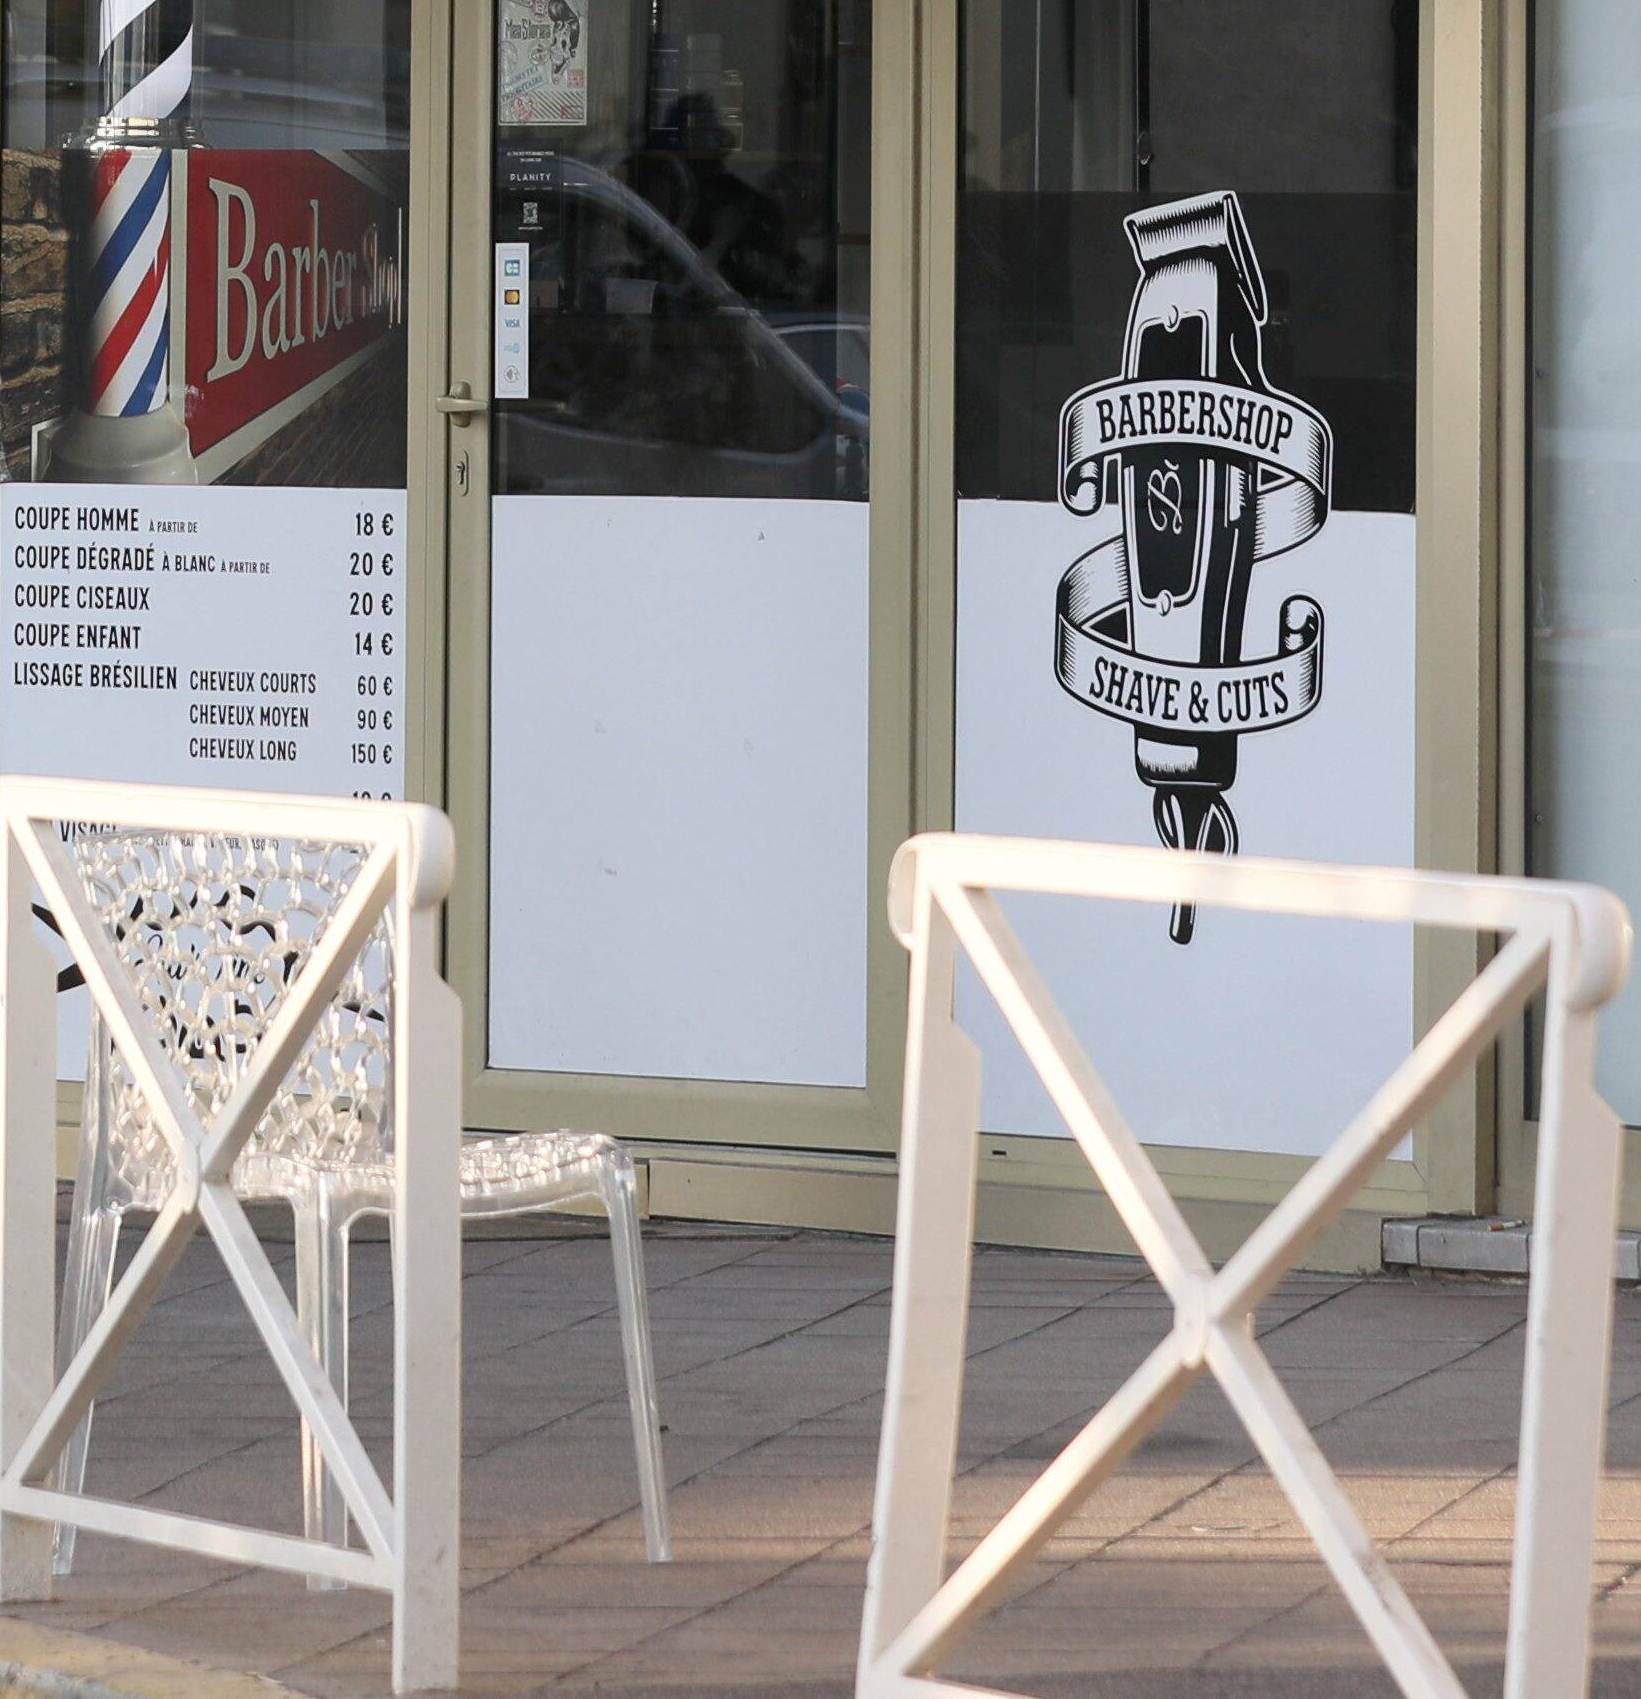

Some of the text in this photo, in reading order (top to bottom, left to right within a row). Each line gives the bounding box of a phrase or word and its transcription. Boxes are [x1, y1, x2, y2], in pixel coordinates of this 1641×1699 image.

[509, 173, 552, 182] PLANITY
[207, 176, 357, 384] Barber
[505, 319, 521, 329] VISA
[1096, 390, 1293, 455] BARBERSHOP
[15, 507, 70, 530] COUPE
[78, 508, 139, 531] HOMME
[157, 521, 185, 532] PARTIR
[188, 522, 197, 533] DE
[356, 513, 373, 536] 18
[382, 513, 393, 536] €
[15, 546, 69, 569] COUPE
[77, 542, 154, 571] DÉGRADÉ
[162, 553, 169, 571] À
[175, 555, 215, 572] BLANC
[229, 562, 257, 573] PARTIR
[260, 563, 270, 574] DE
[351, 553, 373, 575] 20
[382, 554, 393, 576] €
[15, 584, 392, 615] COUPE CISEAUX 20 €
[15, 623, 392, 655] COUPE ENFANT 14 €
[15, 661, 392, 696] LISSAGE BRÉSILIEN CHEVEUX COURTS 60 €
[1089, 655, 1289, 724] SHAVE & CUTS
[190, 704, 392, 730] CHEVEUX MOYEN 90 €
[190, 738, 391, 764] CHEVEUX LONG 150 €
